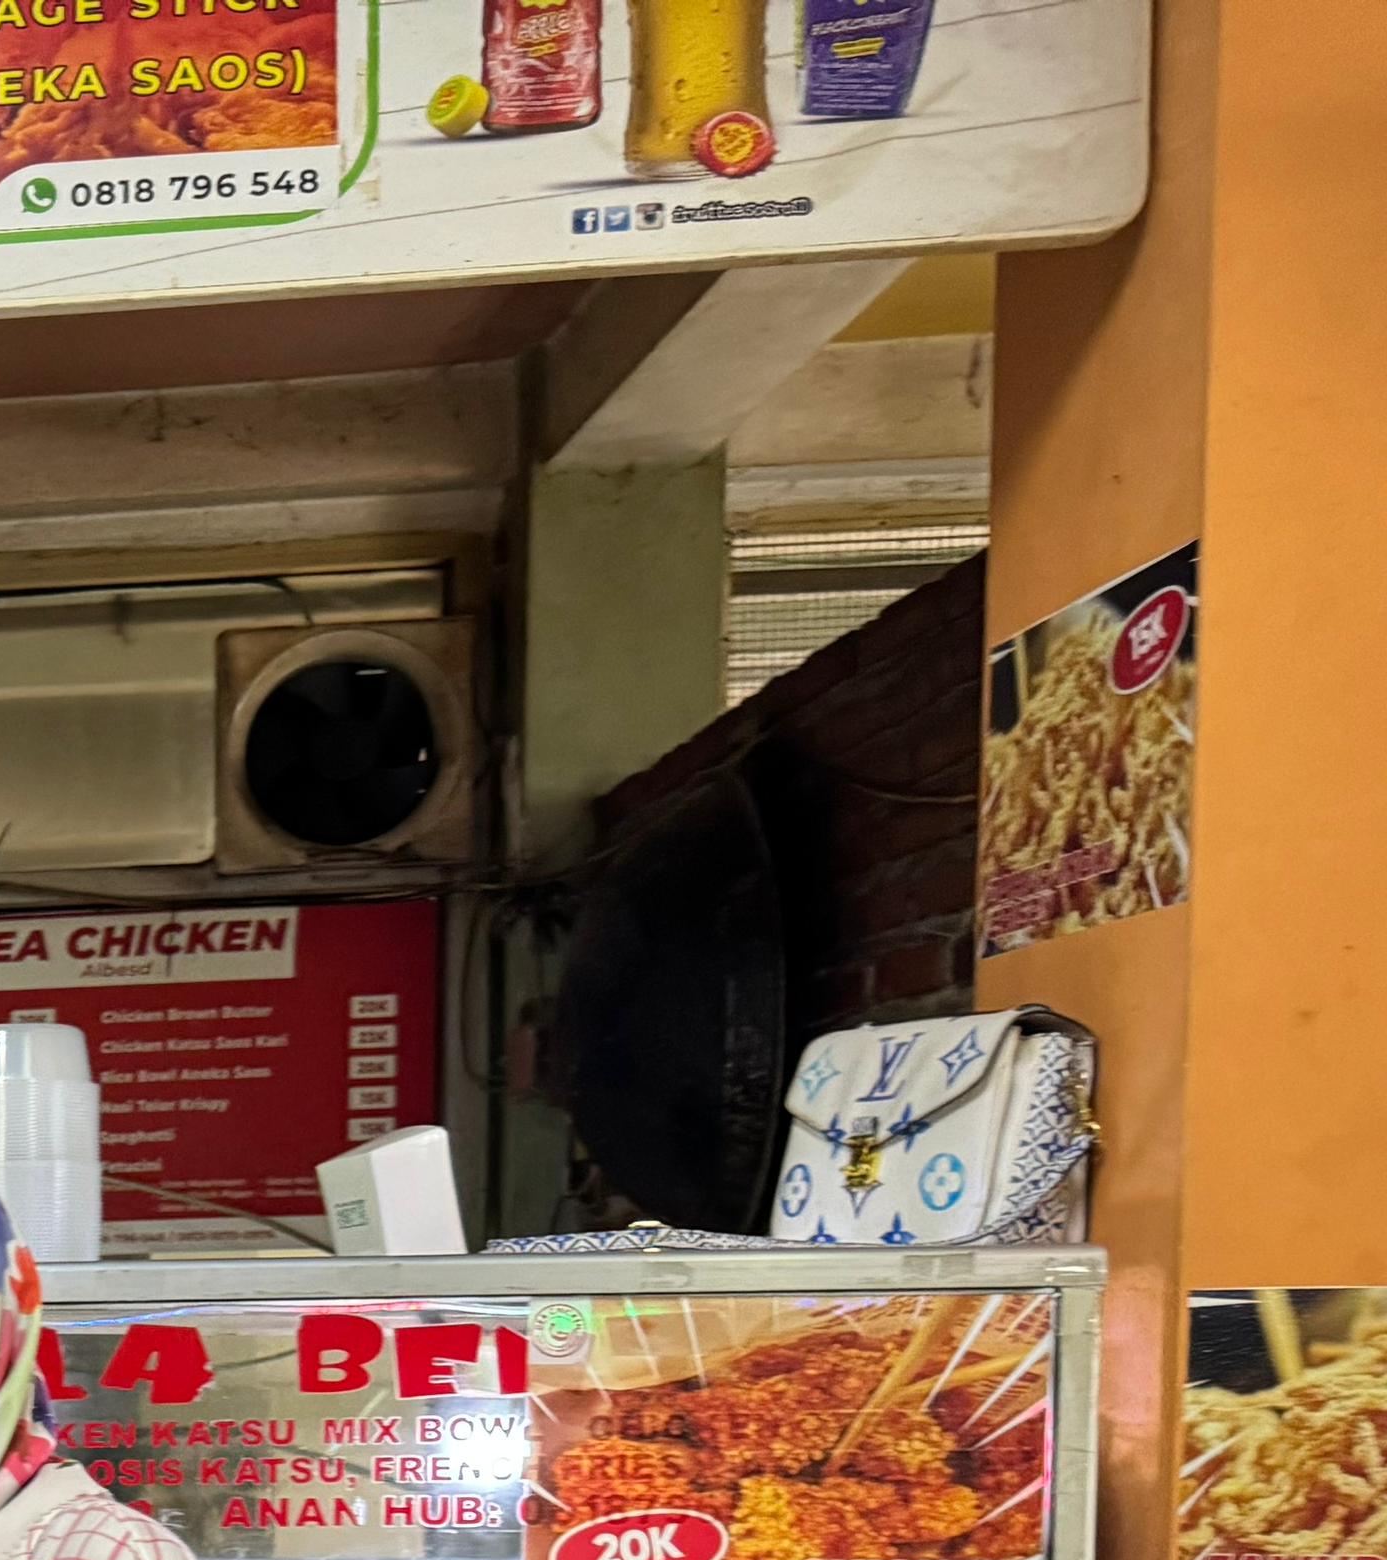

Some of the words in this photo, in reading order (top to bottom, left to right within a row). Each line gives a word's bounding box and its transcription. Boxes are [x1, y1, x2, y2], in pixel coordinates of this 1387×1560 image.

[129, 48, 307, 96] SAOS)
[70, 179, 155, 207] 0818
[168, 174, 237, 201] 796
[249, 168, 320, 197] 548
[66, 918, 289, 959] CHICKEN
[151, 1418, 297, 1447] KATSU
[323, 1416, 402, 1445] MIX
[199, 1456, 359, 1491] KATSU,
